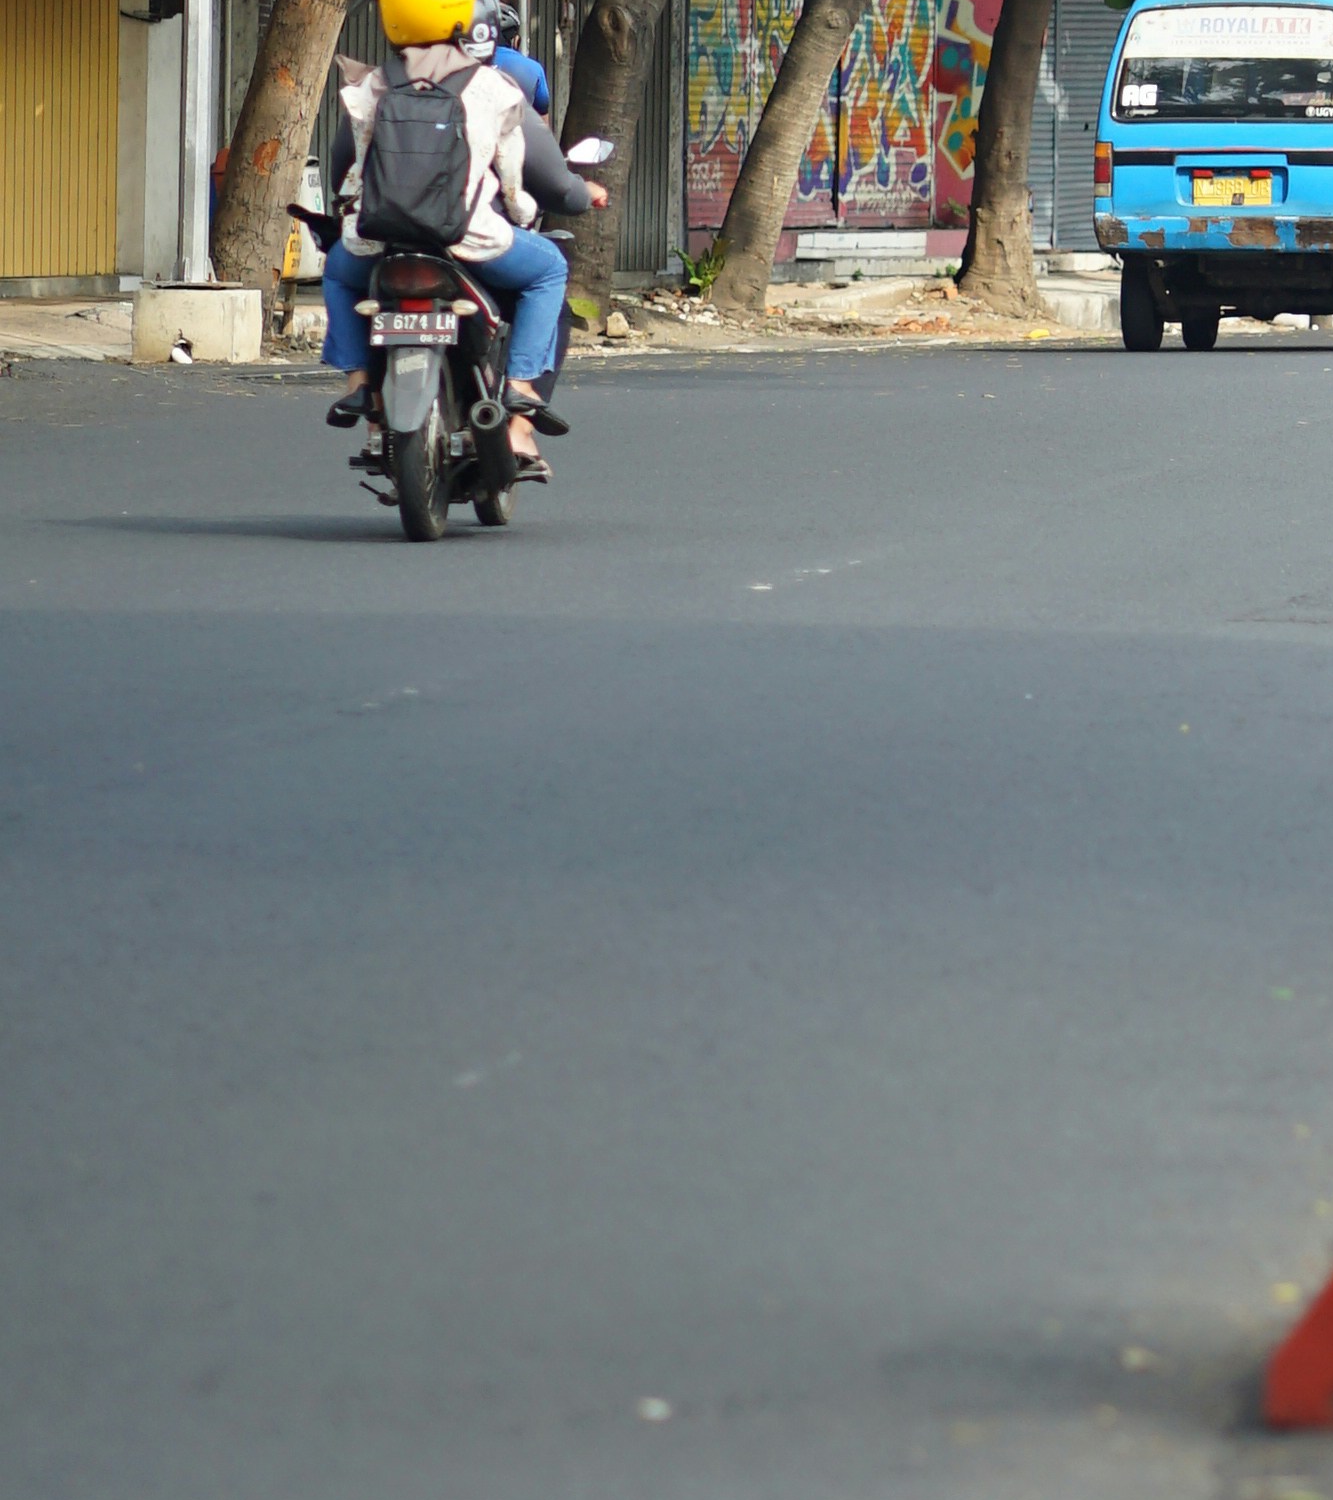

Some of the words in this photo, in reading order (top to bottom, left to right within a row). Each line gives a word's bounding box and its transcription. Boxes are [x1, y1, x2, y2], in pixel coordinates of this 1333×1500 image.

[1200, 17, 1259, 34] ROYAL
[1262, 17, 1311, 34] ATK
[1122, 84, 1158, 107] AG
[373, 314, 385, 330] S
[393, 314, 429, 331] 6174
[435, 314, 456, 330] LH
